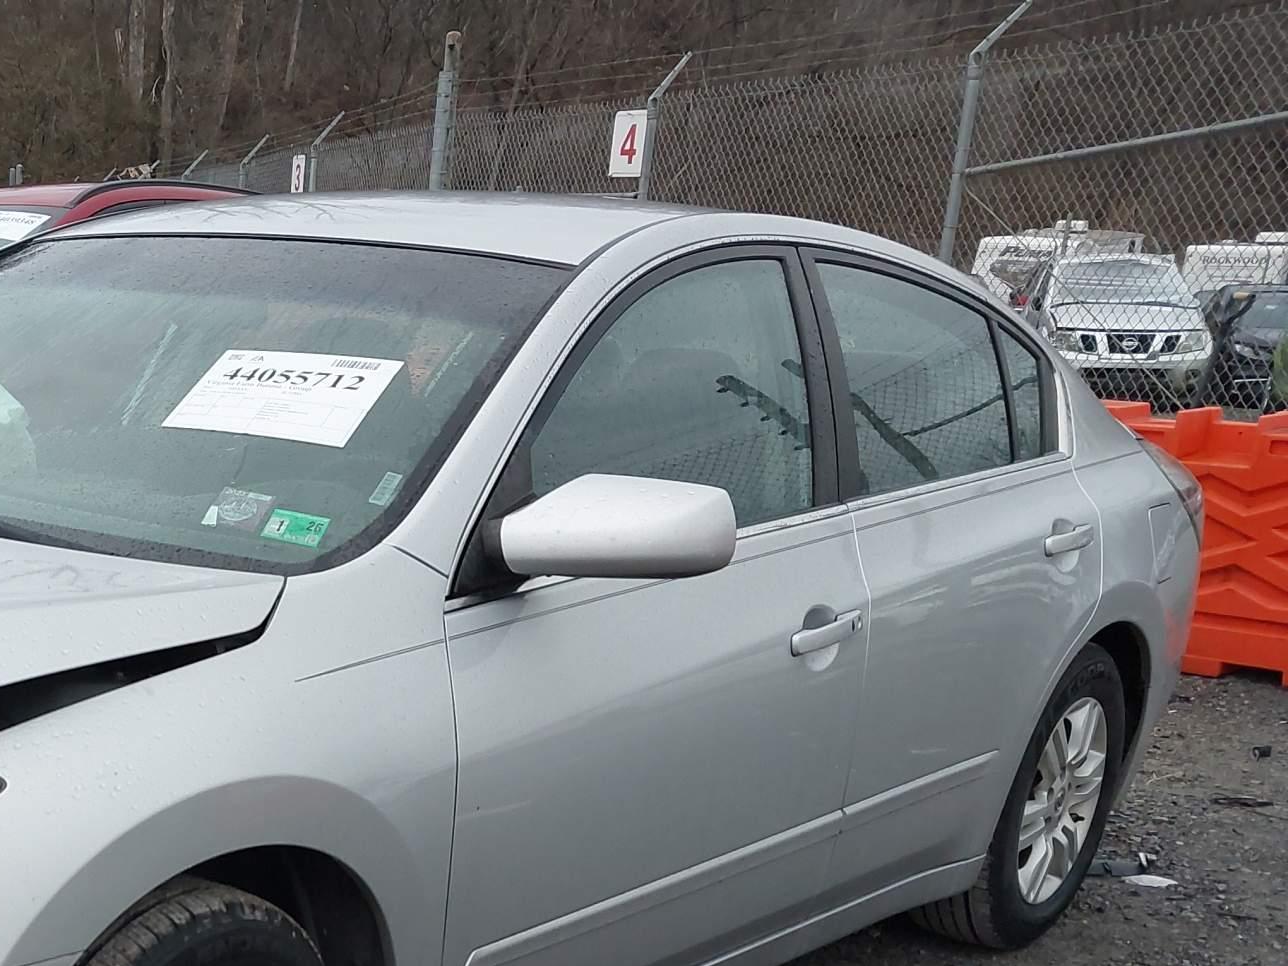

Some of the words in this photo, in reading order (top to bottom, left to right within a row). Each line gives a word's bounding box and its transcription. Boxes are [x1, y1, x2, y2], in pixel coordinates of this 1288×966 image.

[619, 123, 637, 165] 4
[294, 163, 302, 192] 3
[223, 366, 366, 391] 44055712
[276, 519, 285, 532] 1
[306, 521, 325, 533] 26
